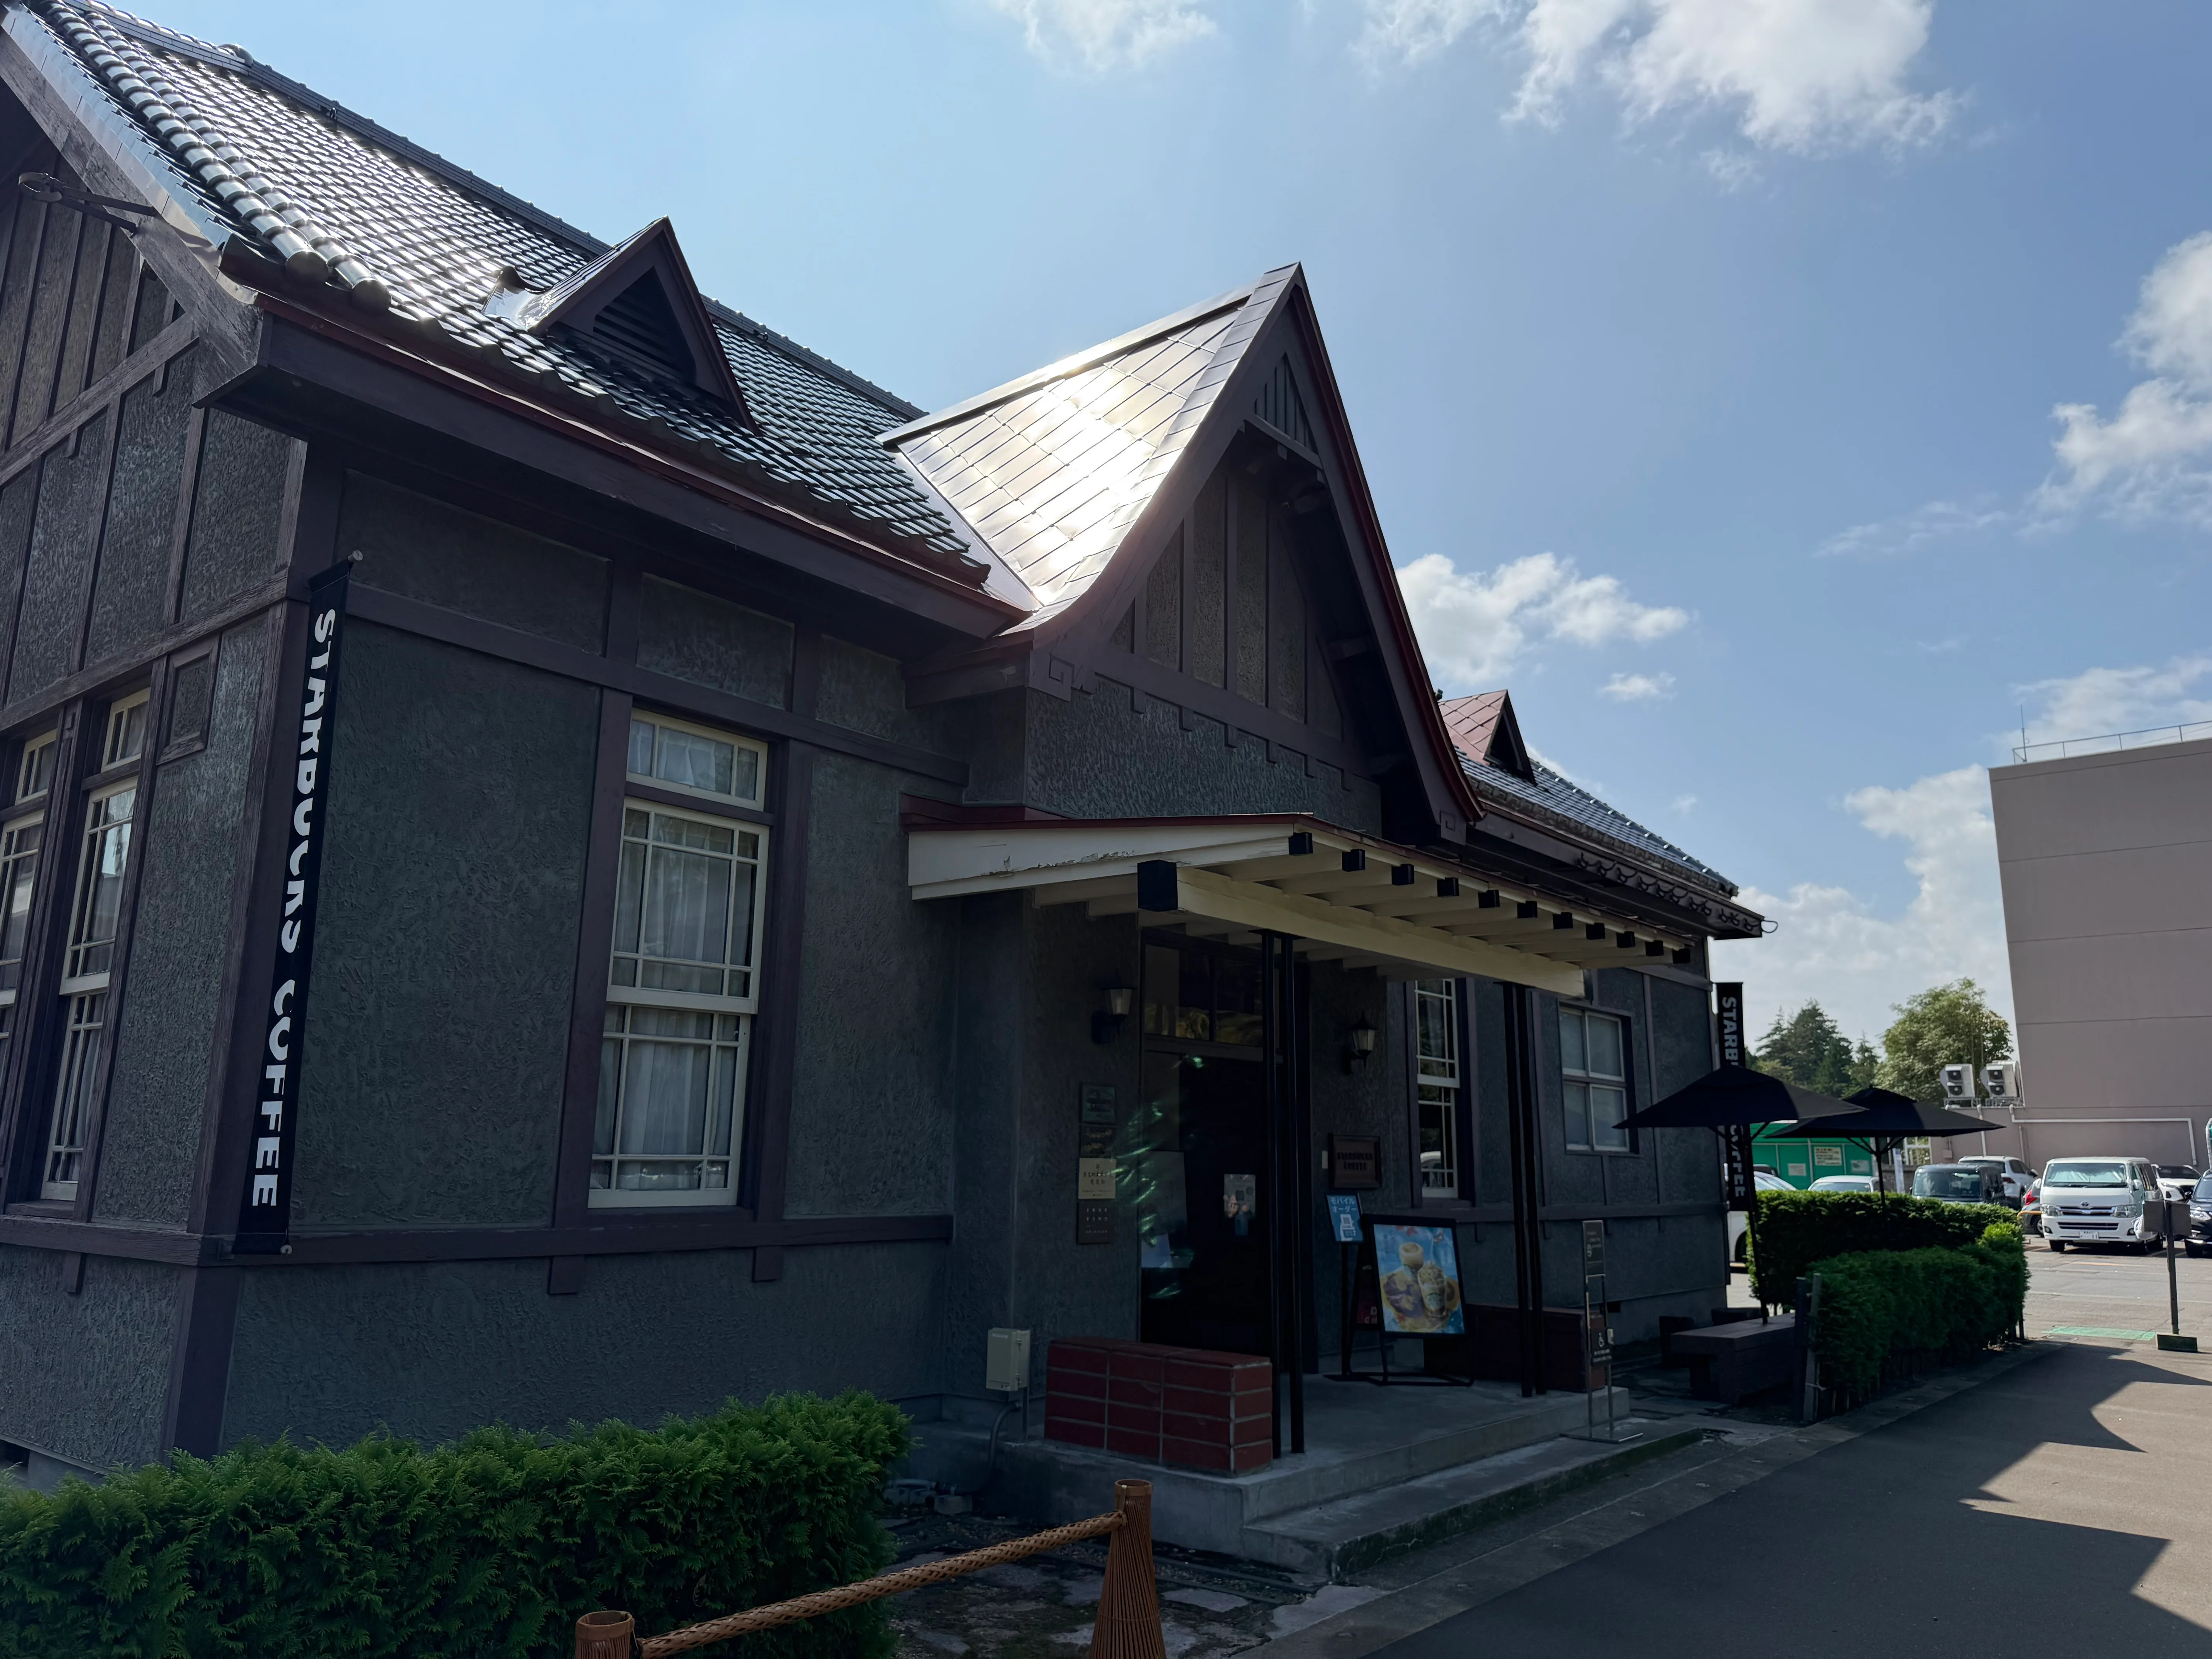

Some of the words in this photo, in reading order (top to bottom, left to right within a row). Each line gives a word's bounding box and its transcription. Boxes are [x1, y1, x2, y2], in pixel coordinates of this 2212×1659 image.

[281, 609, 336, 953] STARBUCKS
[252, 979, 295, 1206] COFFEE
[1722, 996, 1739, 1066] STARB
